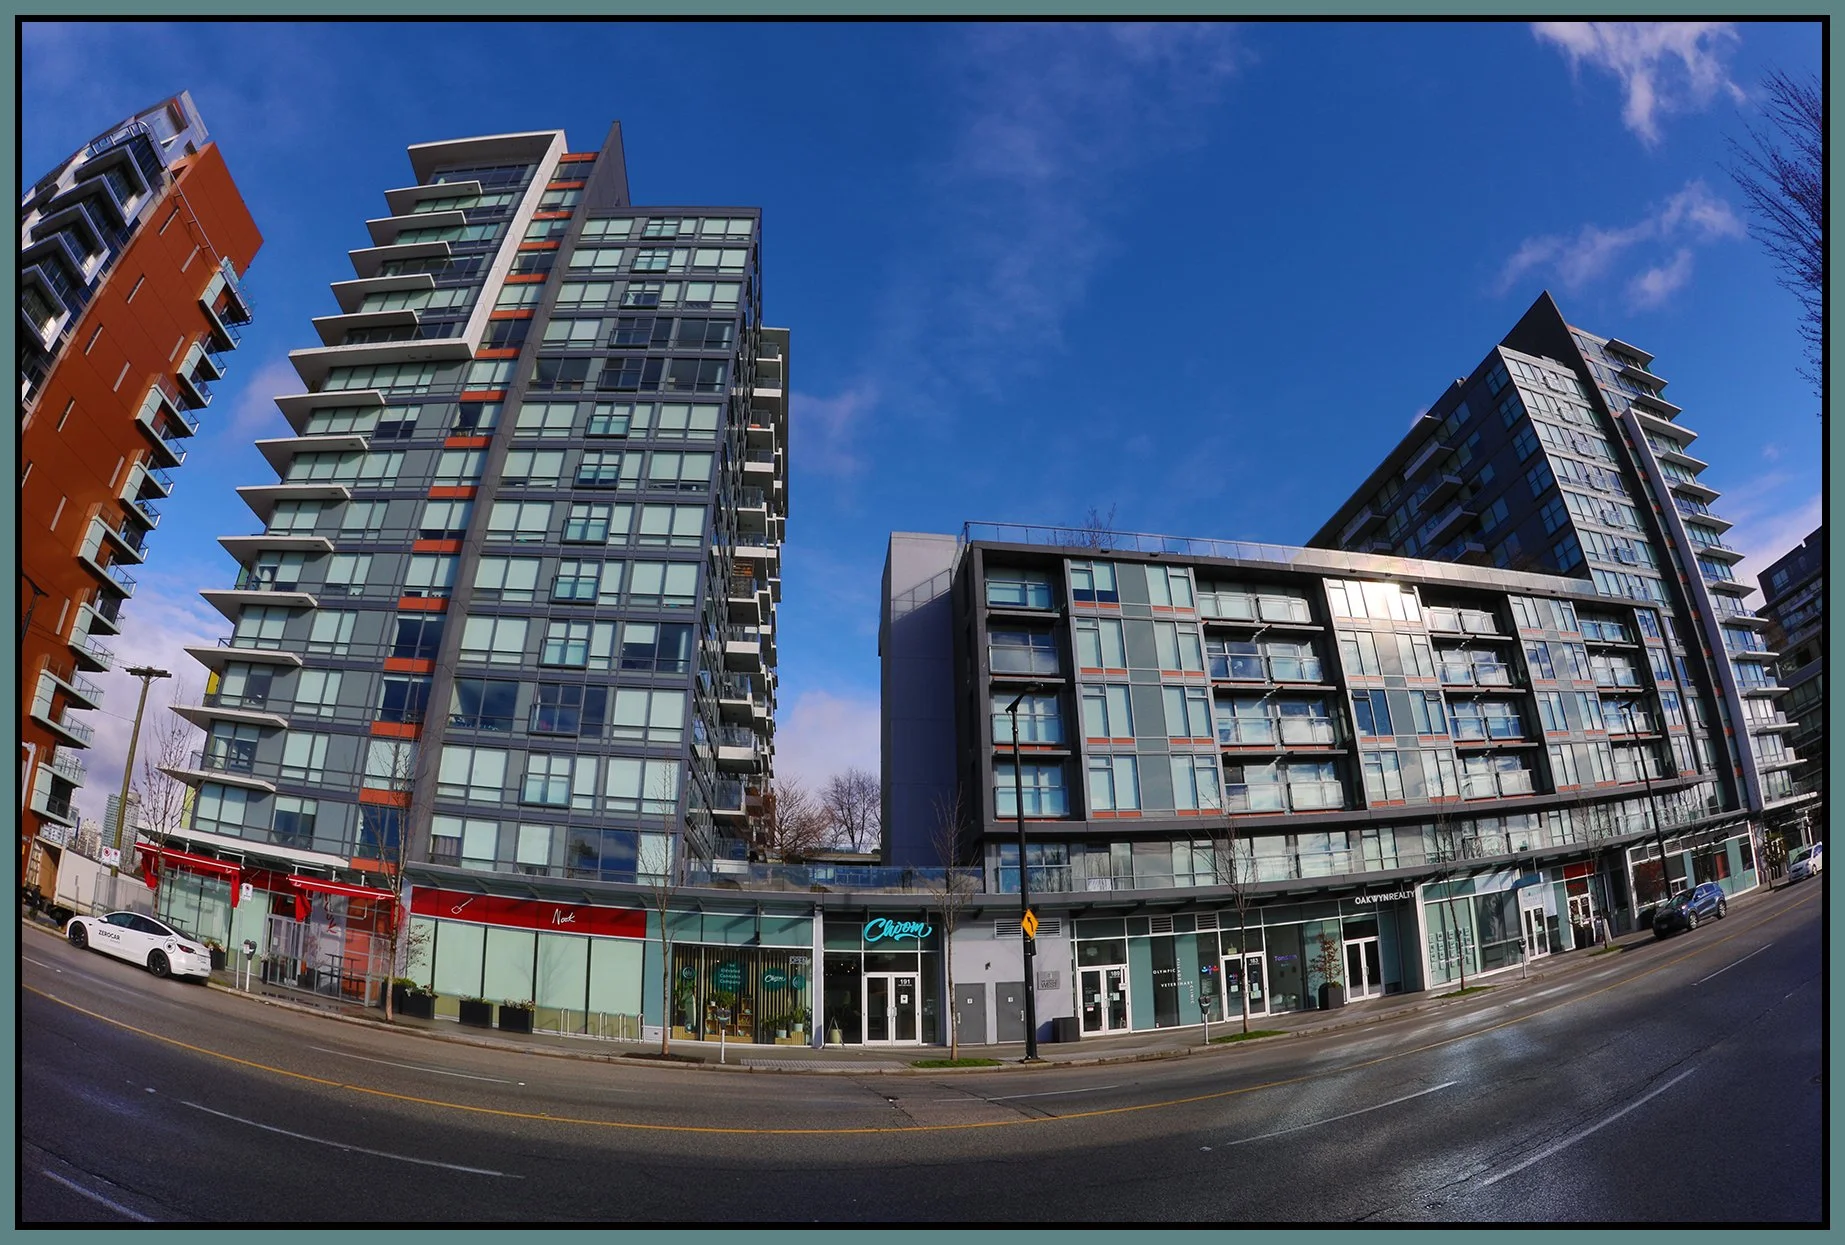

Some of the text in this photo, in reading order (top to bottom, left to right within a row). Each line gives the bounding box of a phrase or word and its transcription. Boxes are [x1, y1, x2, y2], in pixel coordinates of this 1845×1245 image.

[552, 908, 576, 925] Nook
[98, 929, 121, 941] ZEROCAR
[863, 917, 933, 942] Choom
